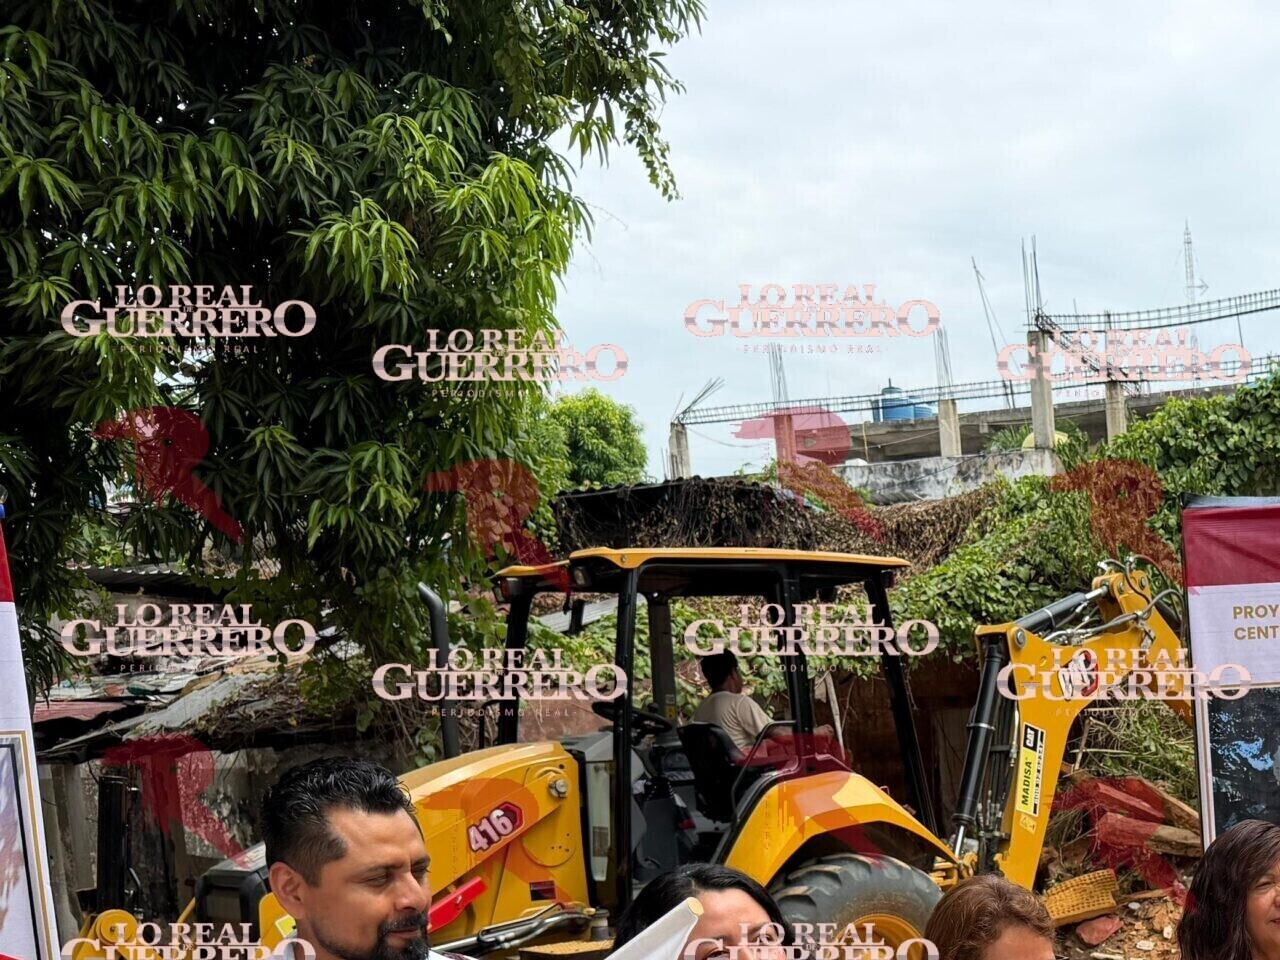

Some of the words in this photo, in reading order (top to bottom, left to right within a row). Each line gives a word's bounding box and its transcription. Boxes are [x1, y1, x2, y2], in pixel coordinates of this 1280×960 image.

[1025, 728, 1037, 746] CAT
[1021, 760, 1033, 806] MADISA
[467, 807, 515, 852] 416
